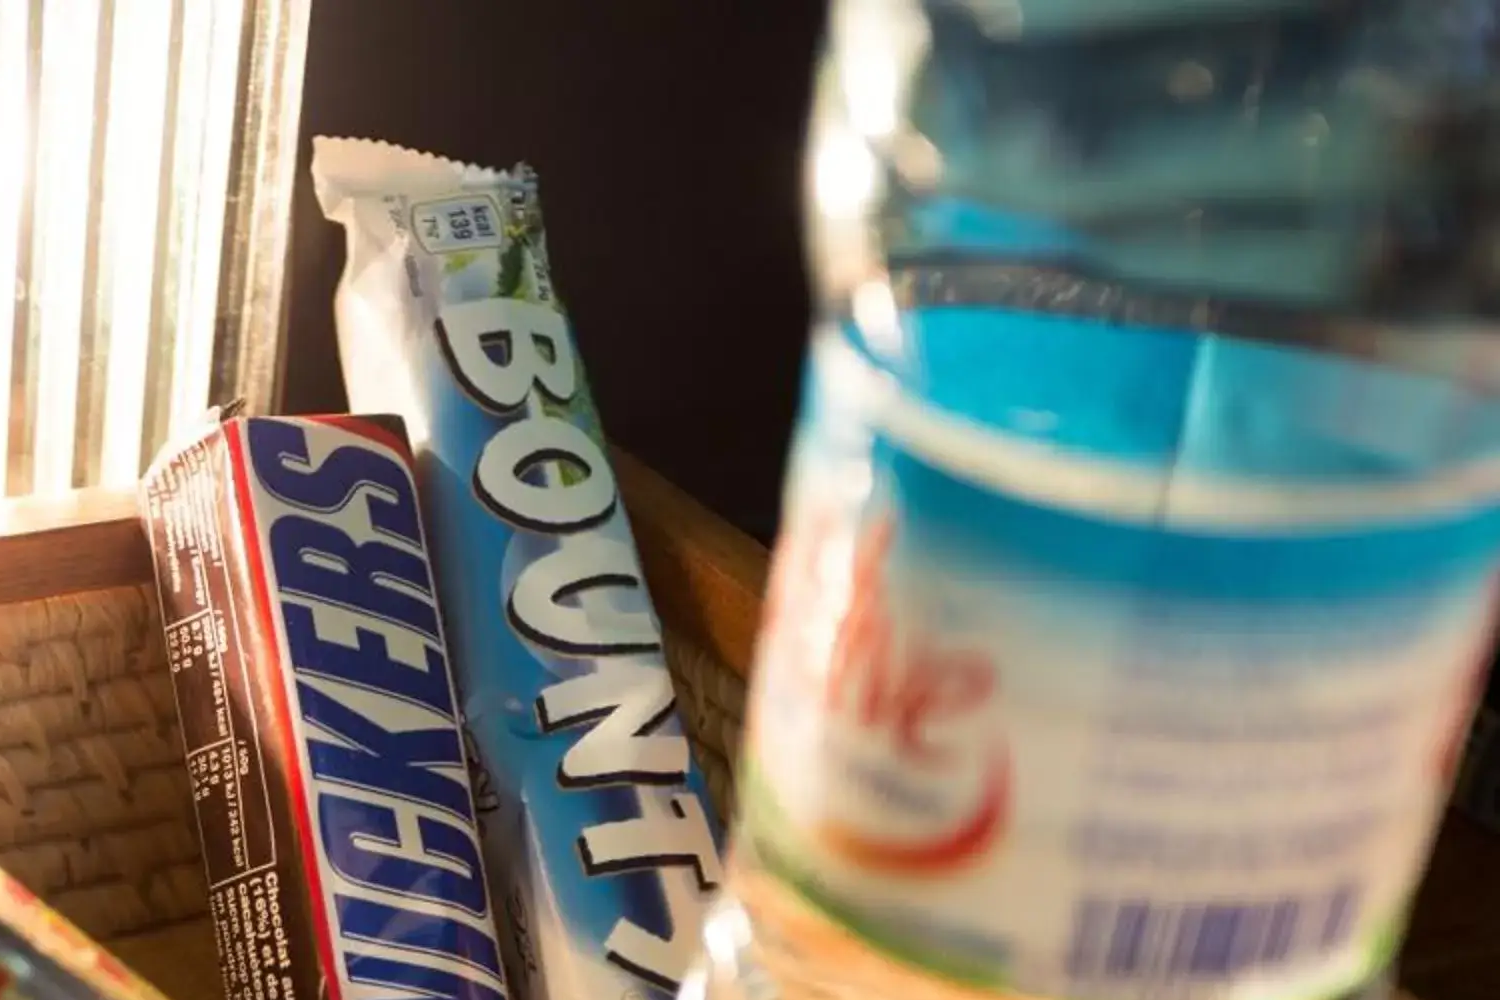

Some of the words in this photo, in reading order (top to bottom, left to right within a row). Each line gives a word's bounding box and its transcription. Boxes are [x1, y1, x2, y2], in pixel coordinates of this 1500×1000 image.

[448, 206, 473, 240] 139
[472, 204, 496, 238] kcal
[435, 298, 720, 993] BOUNTY
[220, 746, 233, 780] 1013
[248, 876, 271, 939] (16%)
[264, 870, 291, 969] Chocolat
[225, 886, 241, 938] sucre,
[233, 940, 249, 984] sirop
[260, 943, 275, 967] et
[264, 971, 280, 1000] de
